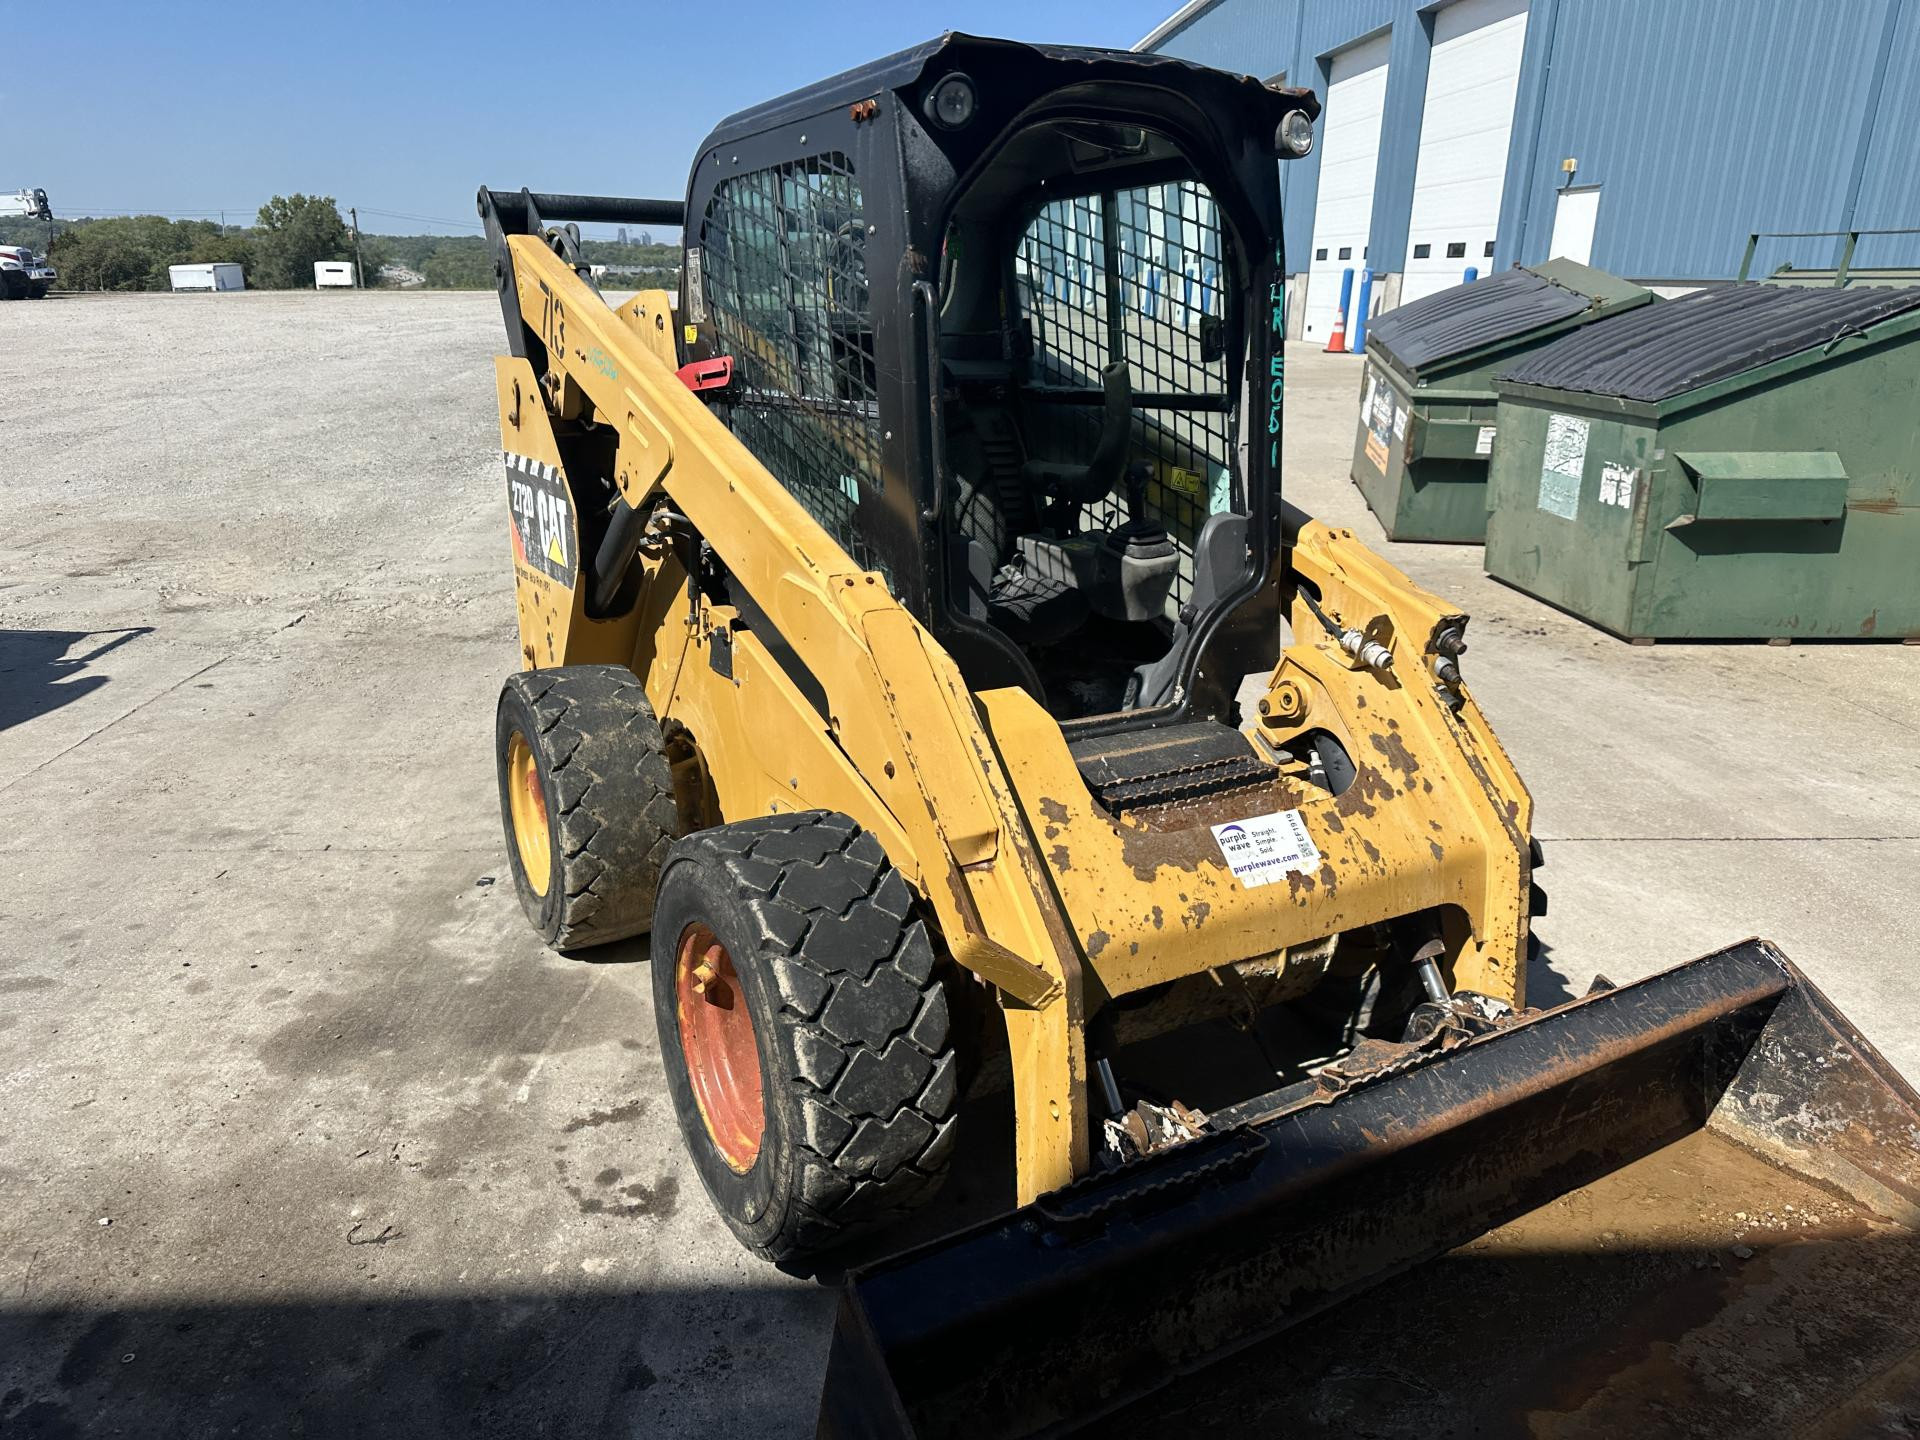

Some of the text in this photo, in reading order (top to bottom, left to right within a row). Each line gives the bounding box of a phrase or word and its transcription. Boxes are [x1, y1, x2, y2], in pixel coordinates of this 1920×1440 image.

[537, 489, 569, 569] CAT
[1251, 827, 1277, 838] Straight.
[1220, 832, 1247, 846] purple
[1255, 837, 1278, 846] Simple.
[1228, 841, 1251, 852] wave
[1259, 846, 1275, 854] Sold.
[1233, 853, 1300, 875] purplewave.com
